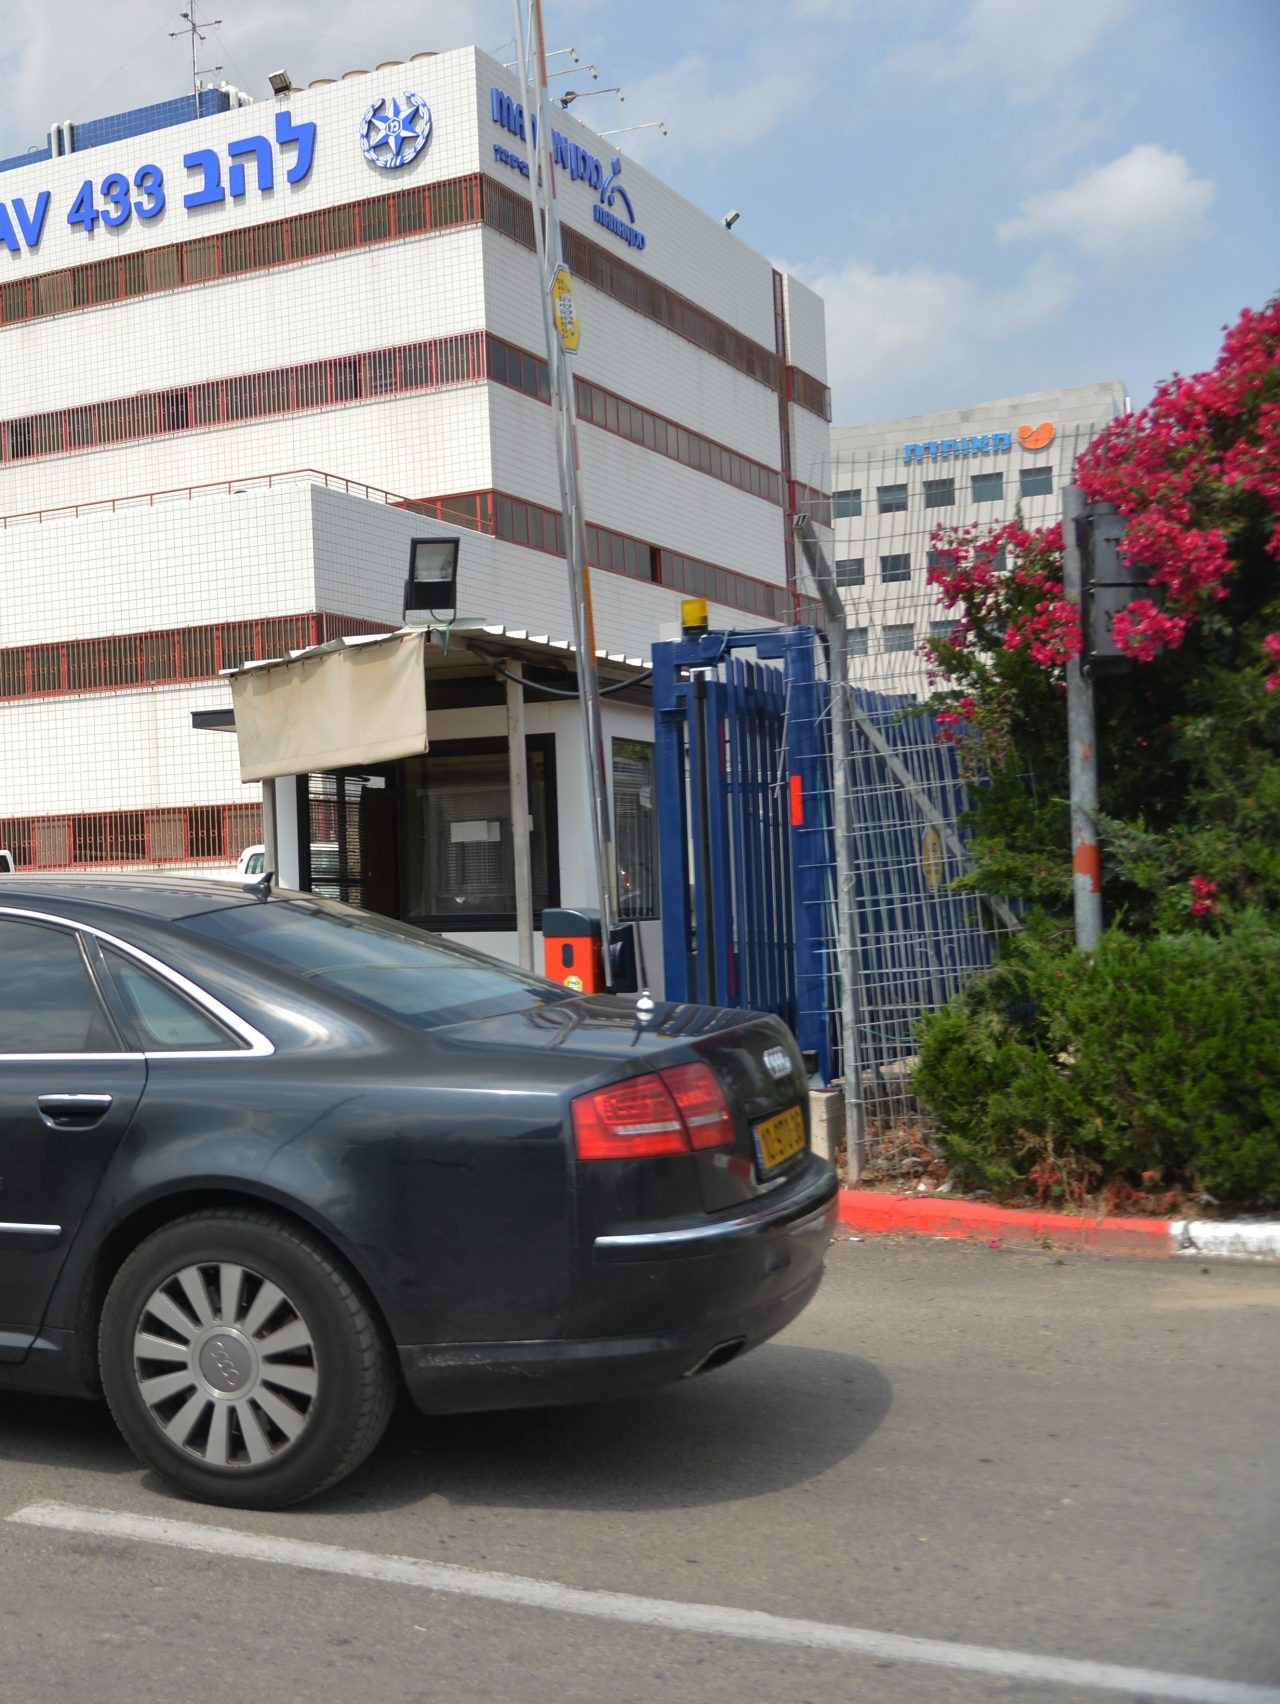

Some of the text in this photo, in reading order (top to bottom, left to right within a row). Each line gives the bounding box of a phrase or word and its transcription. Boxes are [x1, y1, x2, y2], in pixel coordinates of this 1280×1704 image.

[183, 110, 317, 209] להב
[66, 163, 166, 232] 433
[903, 432, 1011, 464] מאוחדת
